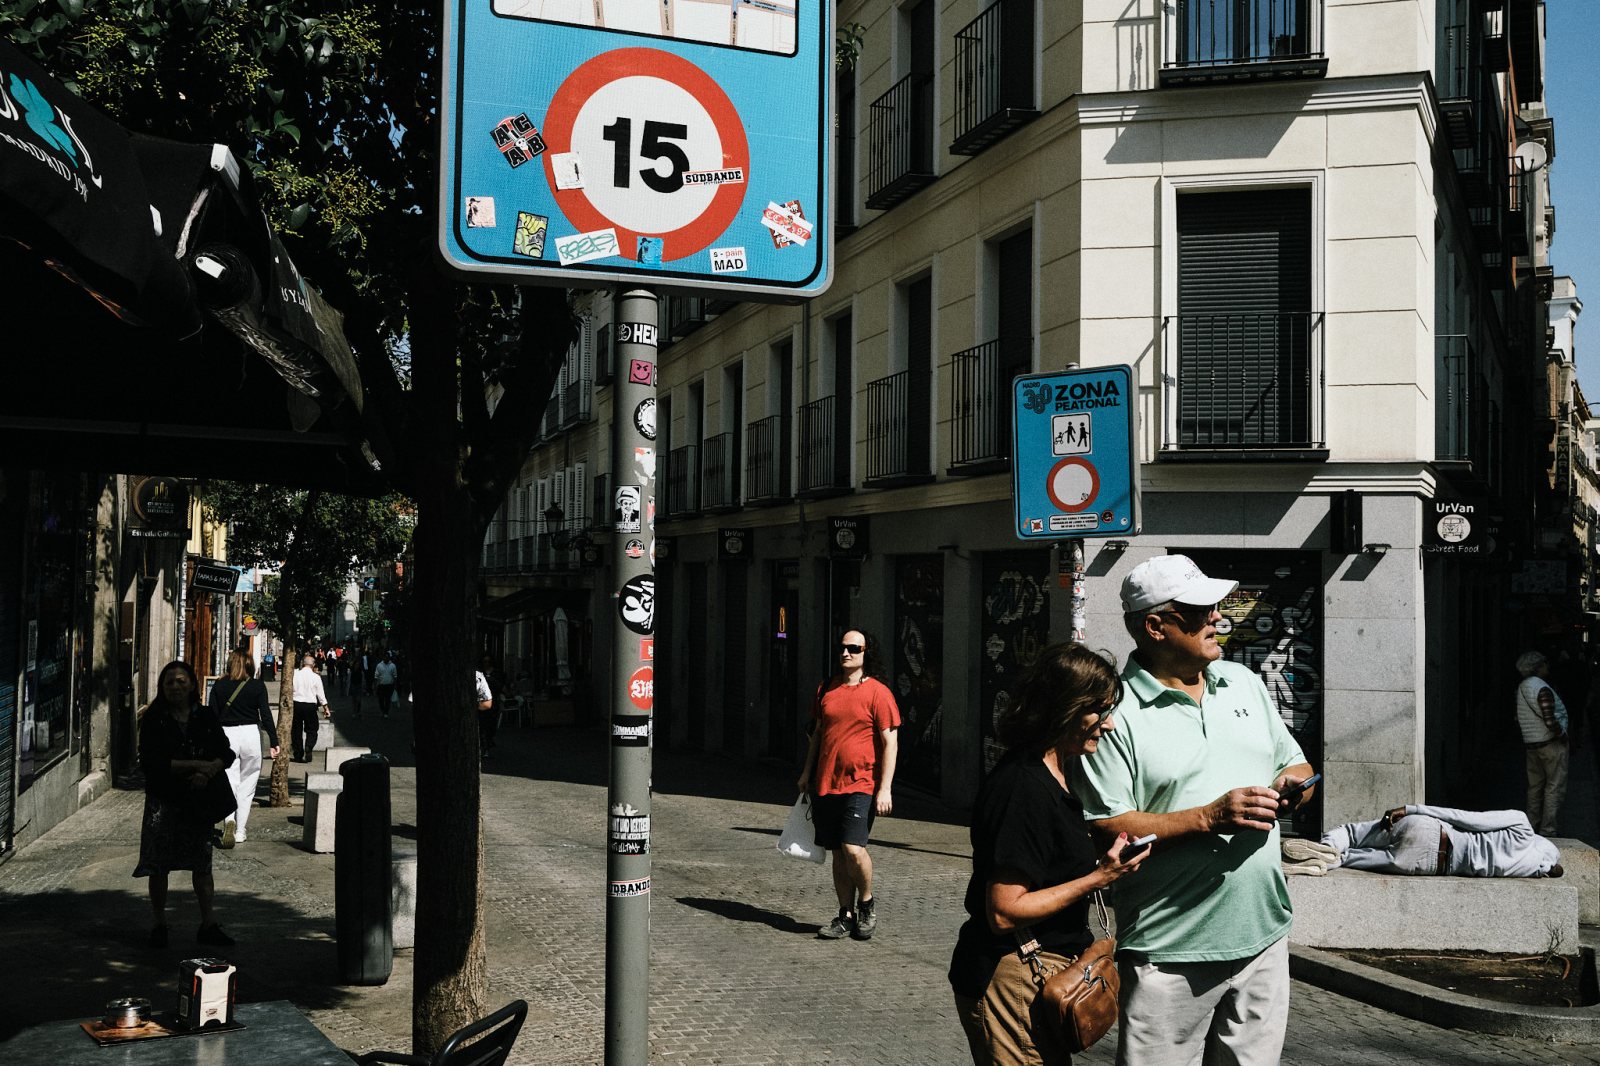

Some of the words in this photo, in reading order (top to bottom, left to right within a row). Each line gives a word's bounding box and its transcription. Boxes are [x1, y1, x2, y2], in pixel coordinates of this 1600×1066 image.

[603, 117, 690, 194] 15
[725, 249, 743, 258] pain
[714, 258, 744, 271] MAD
[1055, 380, 1120, 401] ZONA
[1055, 397, 1121, 412] PEATONAL
[1436, 502, 1475, 513] UrVan
[834, 519, 857, 528] UrVan
[1458, 544, 1480, 553] Food
[612, 723, 648, 737] COMMANDO
